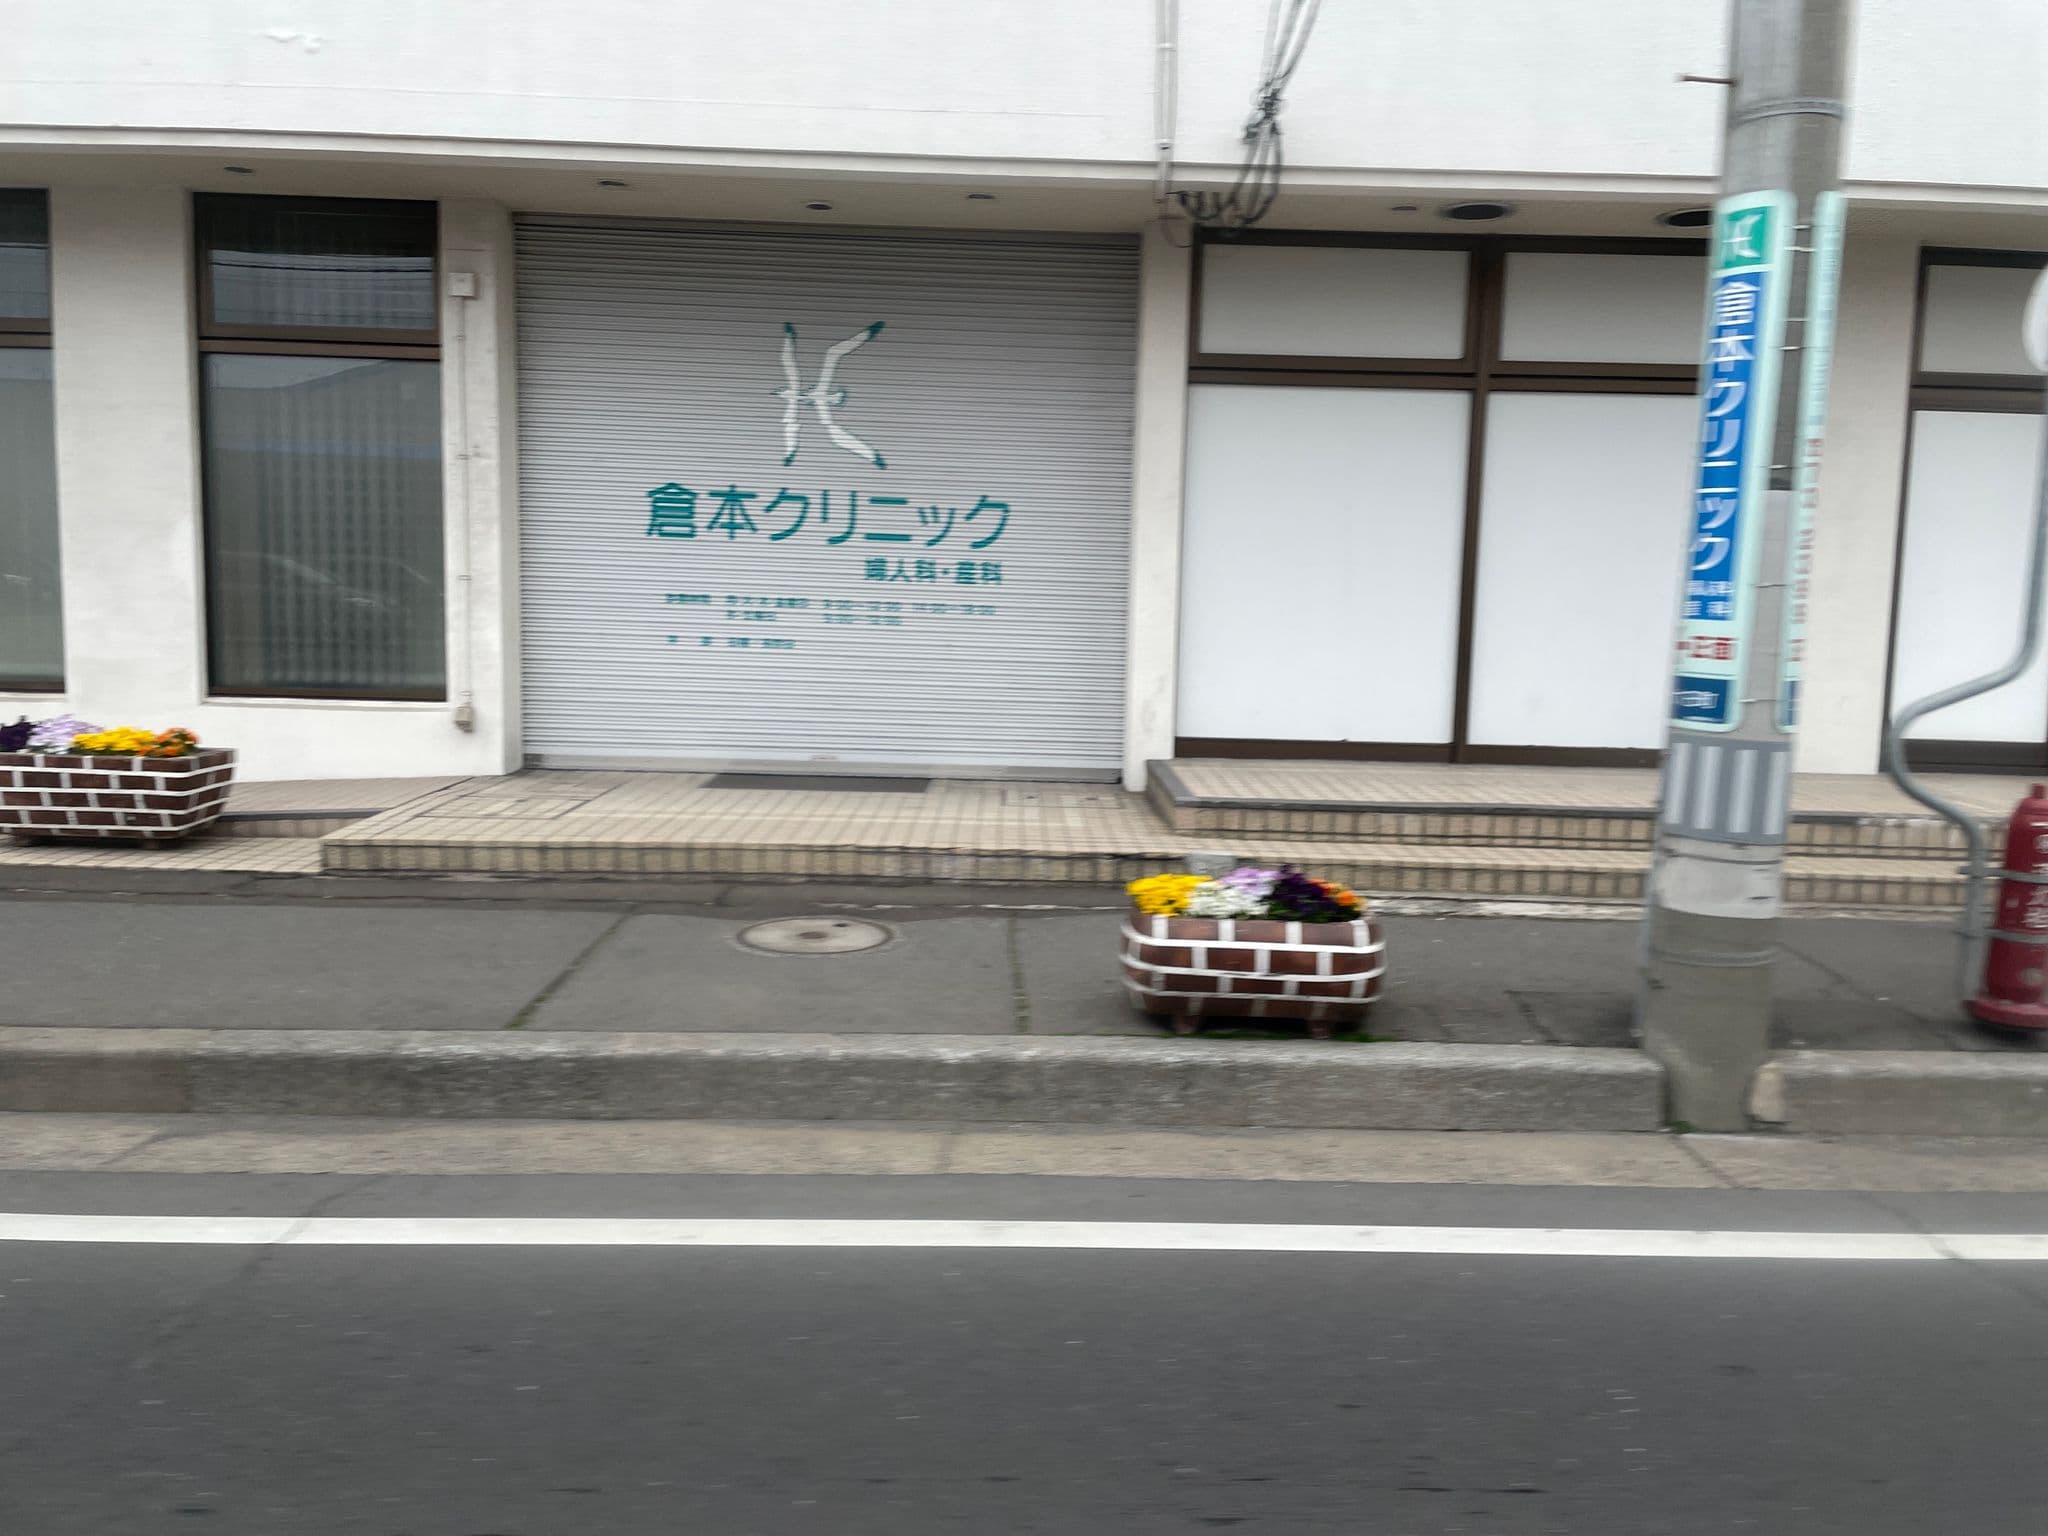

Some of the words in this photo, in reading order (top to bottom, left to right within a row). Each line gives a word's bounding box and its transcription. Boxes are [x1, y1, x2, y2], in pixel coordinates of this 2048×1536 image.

[1689, 281, 1760, 571] 倉本クリニック
[646, 482, 1010, 549] 倉本クリニック
